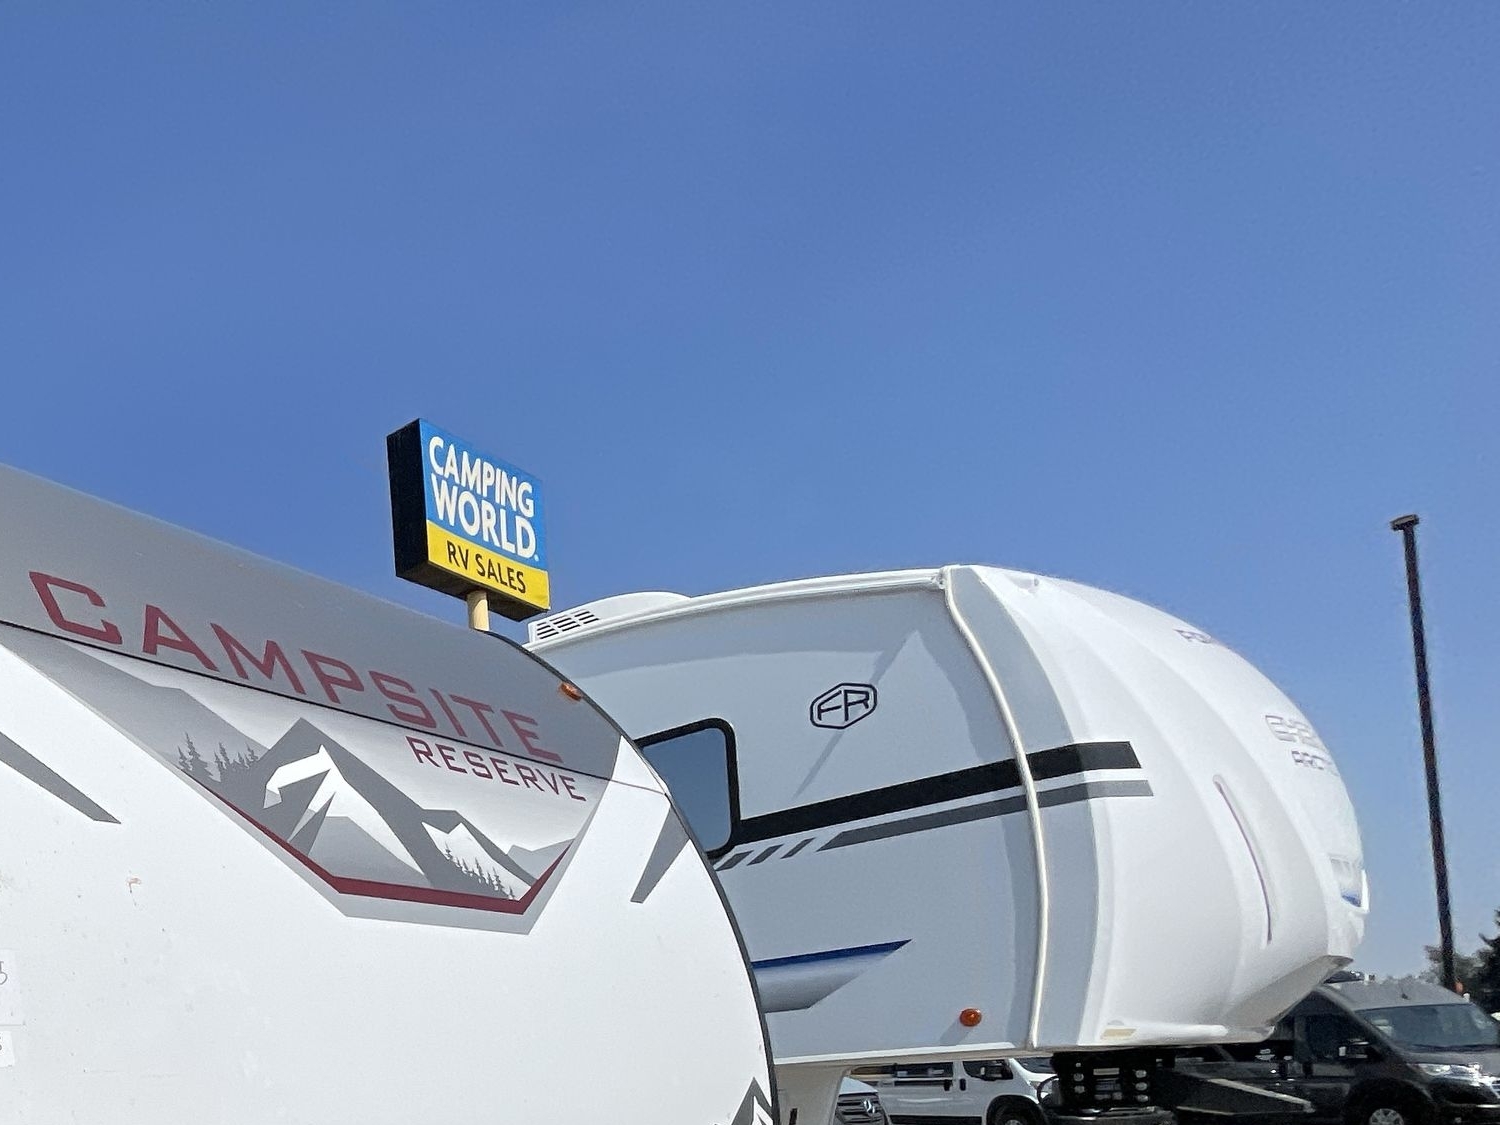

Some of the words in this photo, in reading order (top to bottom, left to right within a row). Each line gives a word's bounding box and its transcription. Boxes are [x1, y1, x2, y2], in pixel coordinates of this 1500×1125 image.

[429, 436, 535, 518] CAMPING
[431, 473, 537, 559] WORLD
[447, 540, 469, 570] RV
[475, 553, 526, 594] SALES
[28, 571, 565, 763] CAMPSITE
[405, 735, 587, 802] RESERVE
